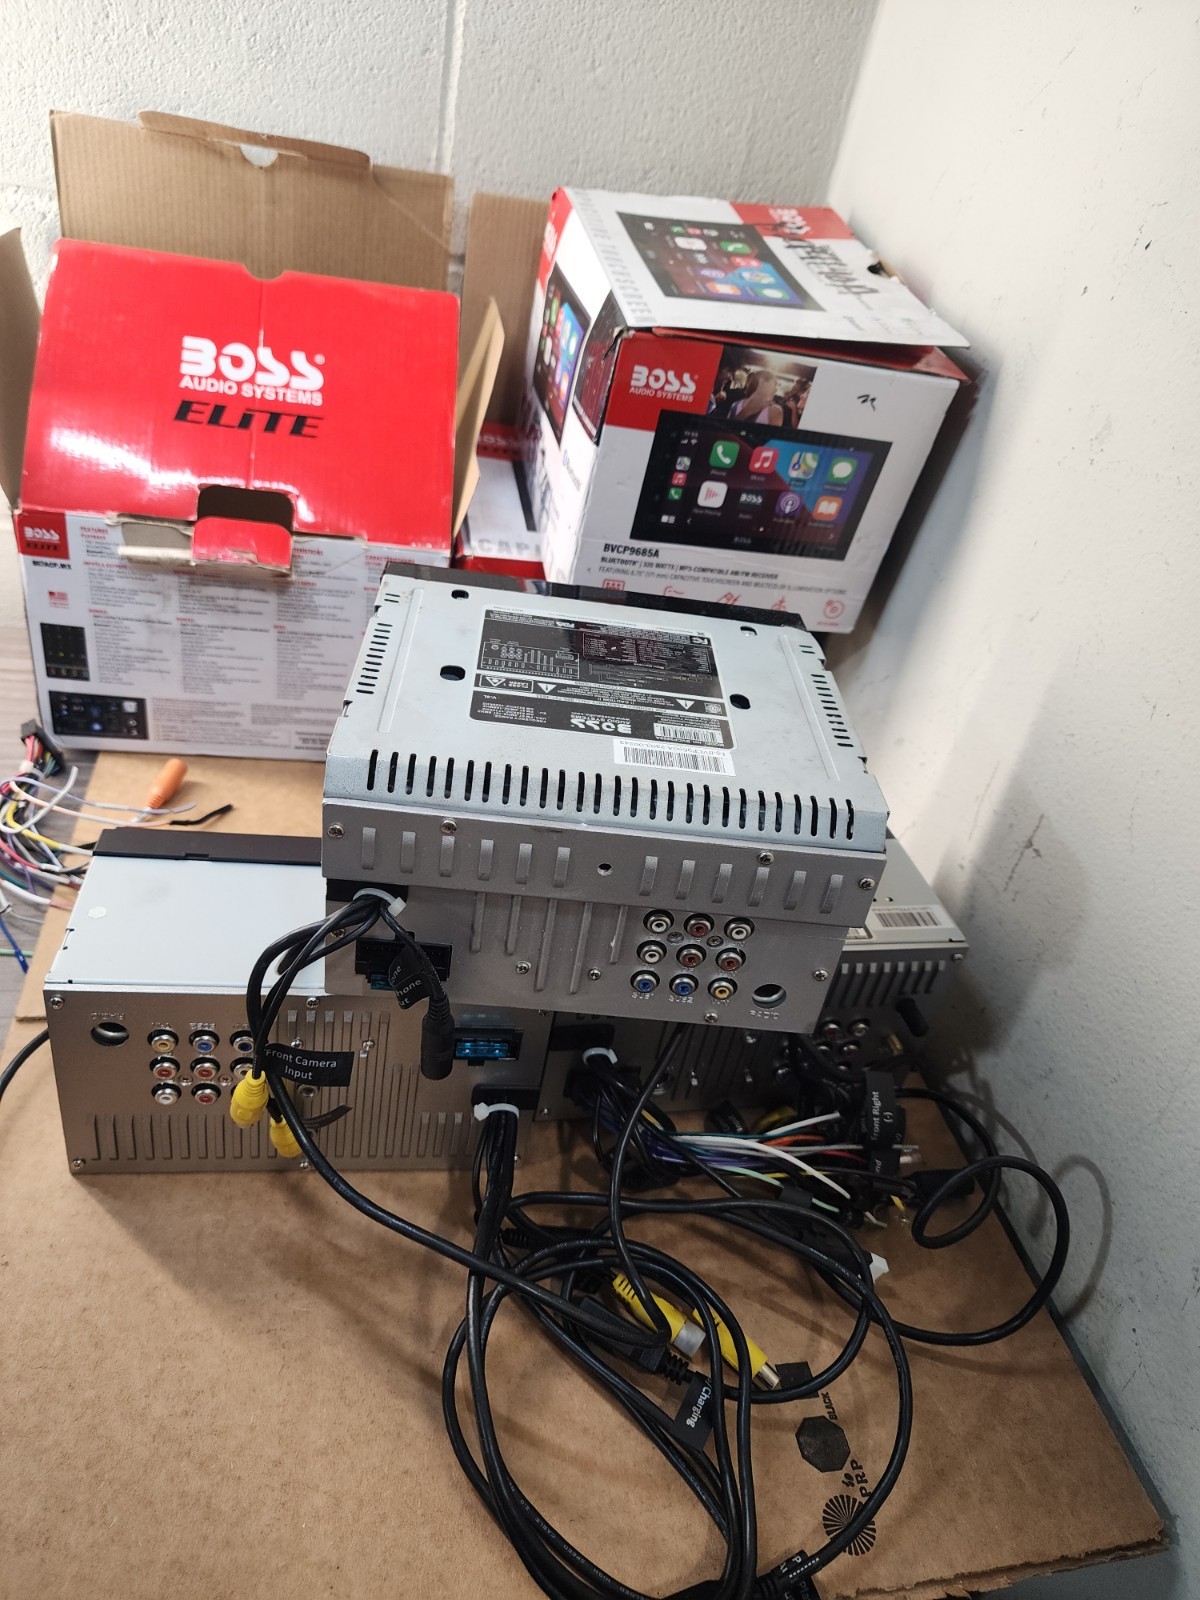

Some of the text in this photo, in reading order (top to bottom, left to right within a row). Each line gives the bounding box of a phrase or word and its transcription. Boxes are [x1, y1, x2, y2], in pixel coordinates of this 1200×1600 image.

[180, 336, 325, 391] BOSS
[630, 364, 698, 394] BOSS
[179, 376, 323, 406] AUDIO SYSTEMS
[629, 386, 694, 403] AUDIO SYSTEMS
[739, 492, 764, 505] BOSS
[23, 526, 61, 541] BOSS
[603, 543, 660, 558] BVCP9685A
[570, 718, 632, 734] BOSS
[266, 1049, 337, 1067] Front Camera
[285, 1065, 312, 1079] Input
[869, 1090, 882, 1140] Front Right
[822, 1391, 838, 1421] BLACK
[850, 1458, 872, 1498] PRP
